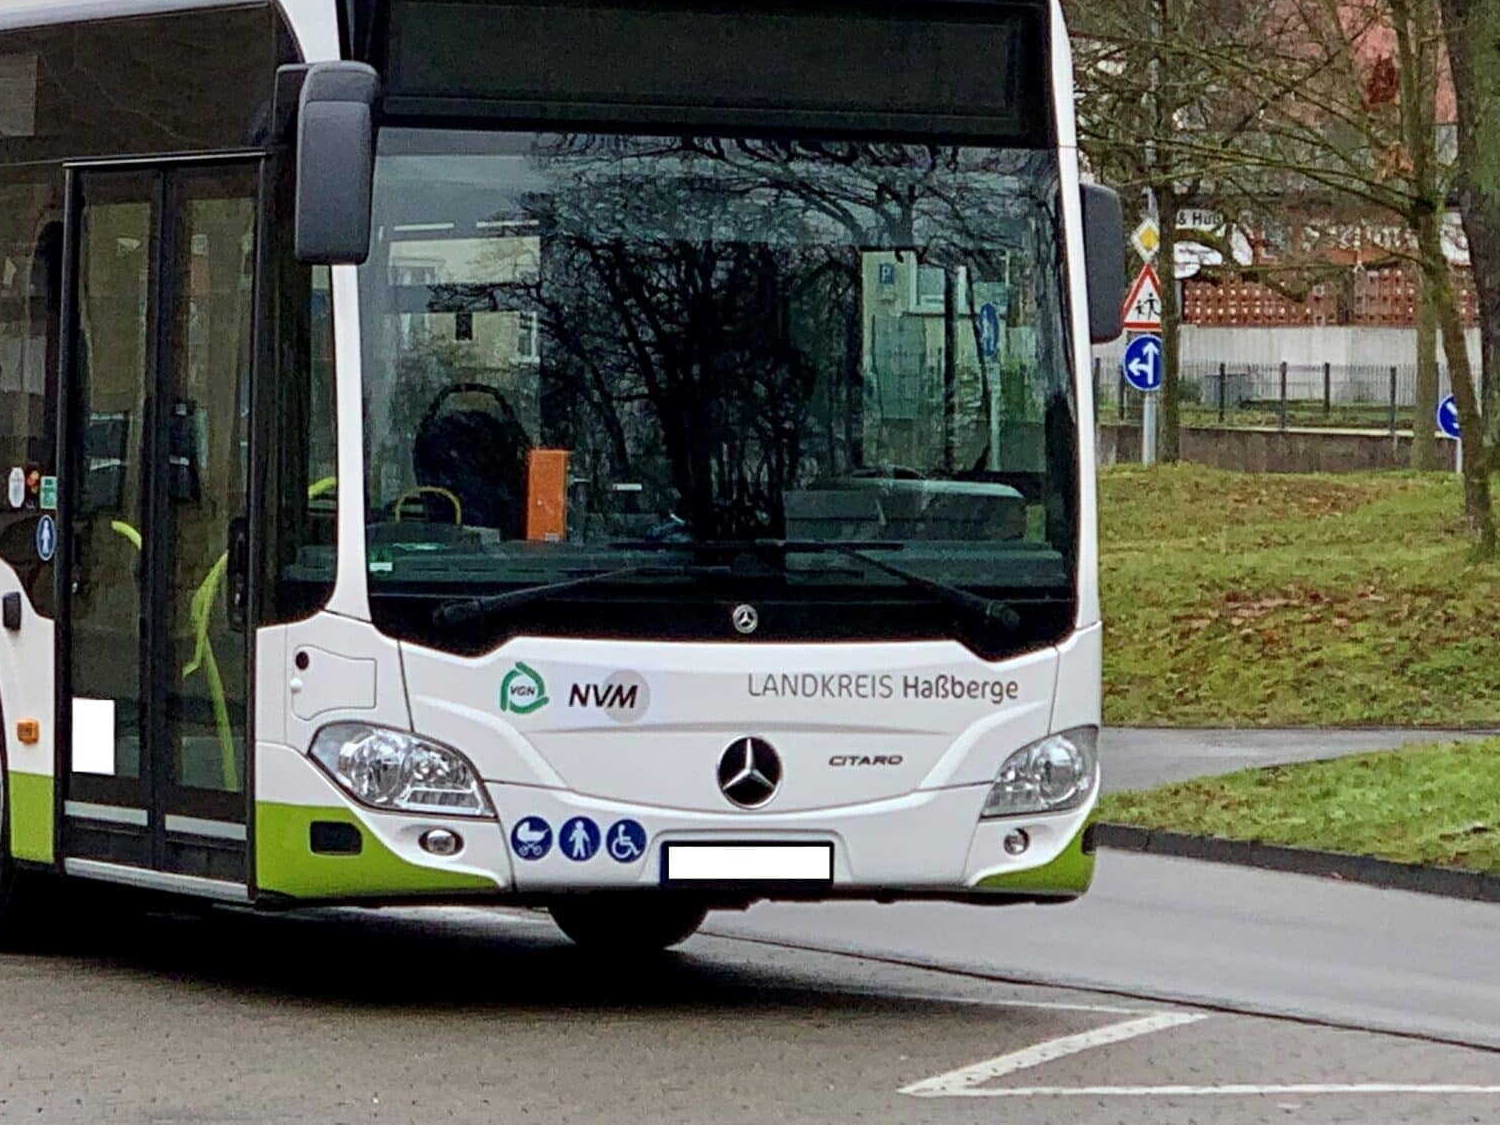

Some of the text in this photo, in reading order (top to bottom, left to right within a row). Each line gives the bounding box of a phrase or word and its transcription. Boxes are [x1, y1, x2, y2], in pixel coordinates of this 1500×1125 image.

[510, 685, 536, 697] VGN
[568, 682, 639, 709] NVM
[747, 673, 1019, 705] LANDKREIS Haßberge
[828, 755, 904, 767] CITARO
